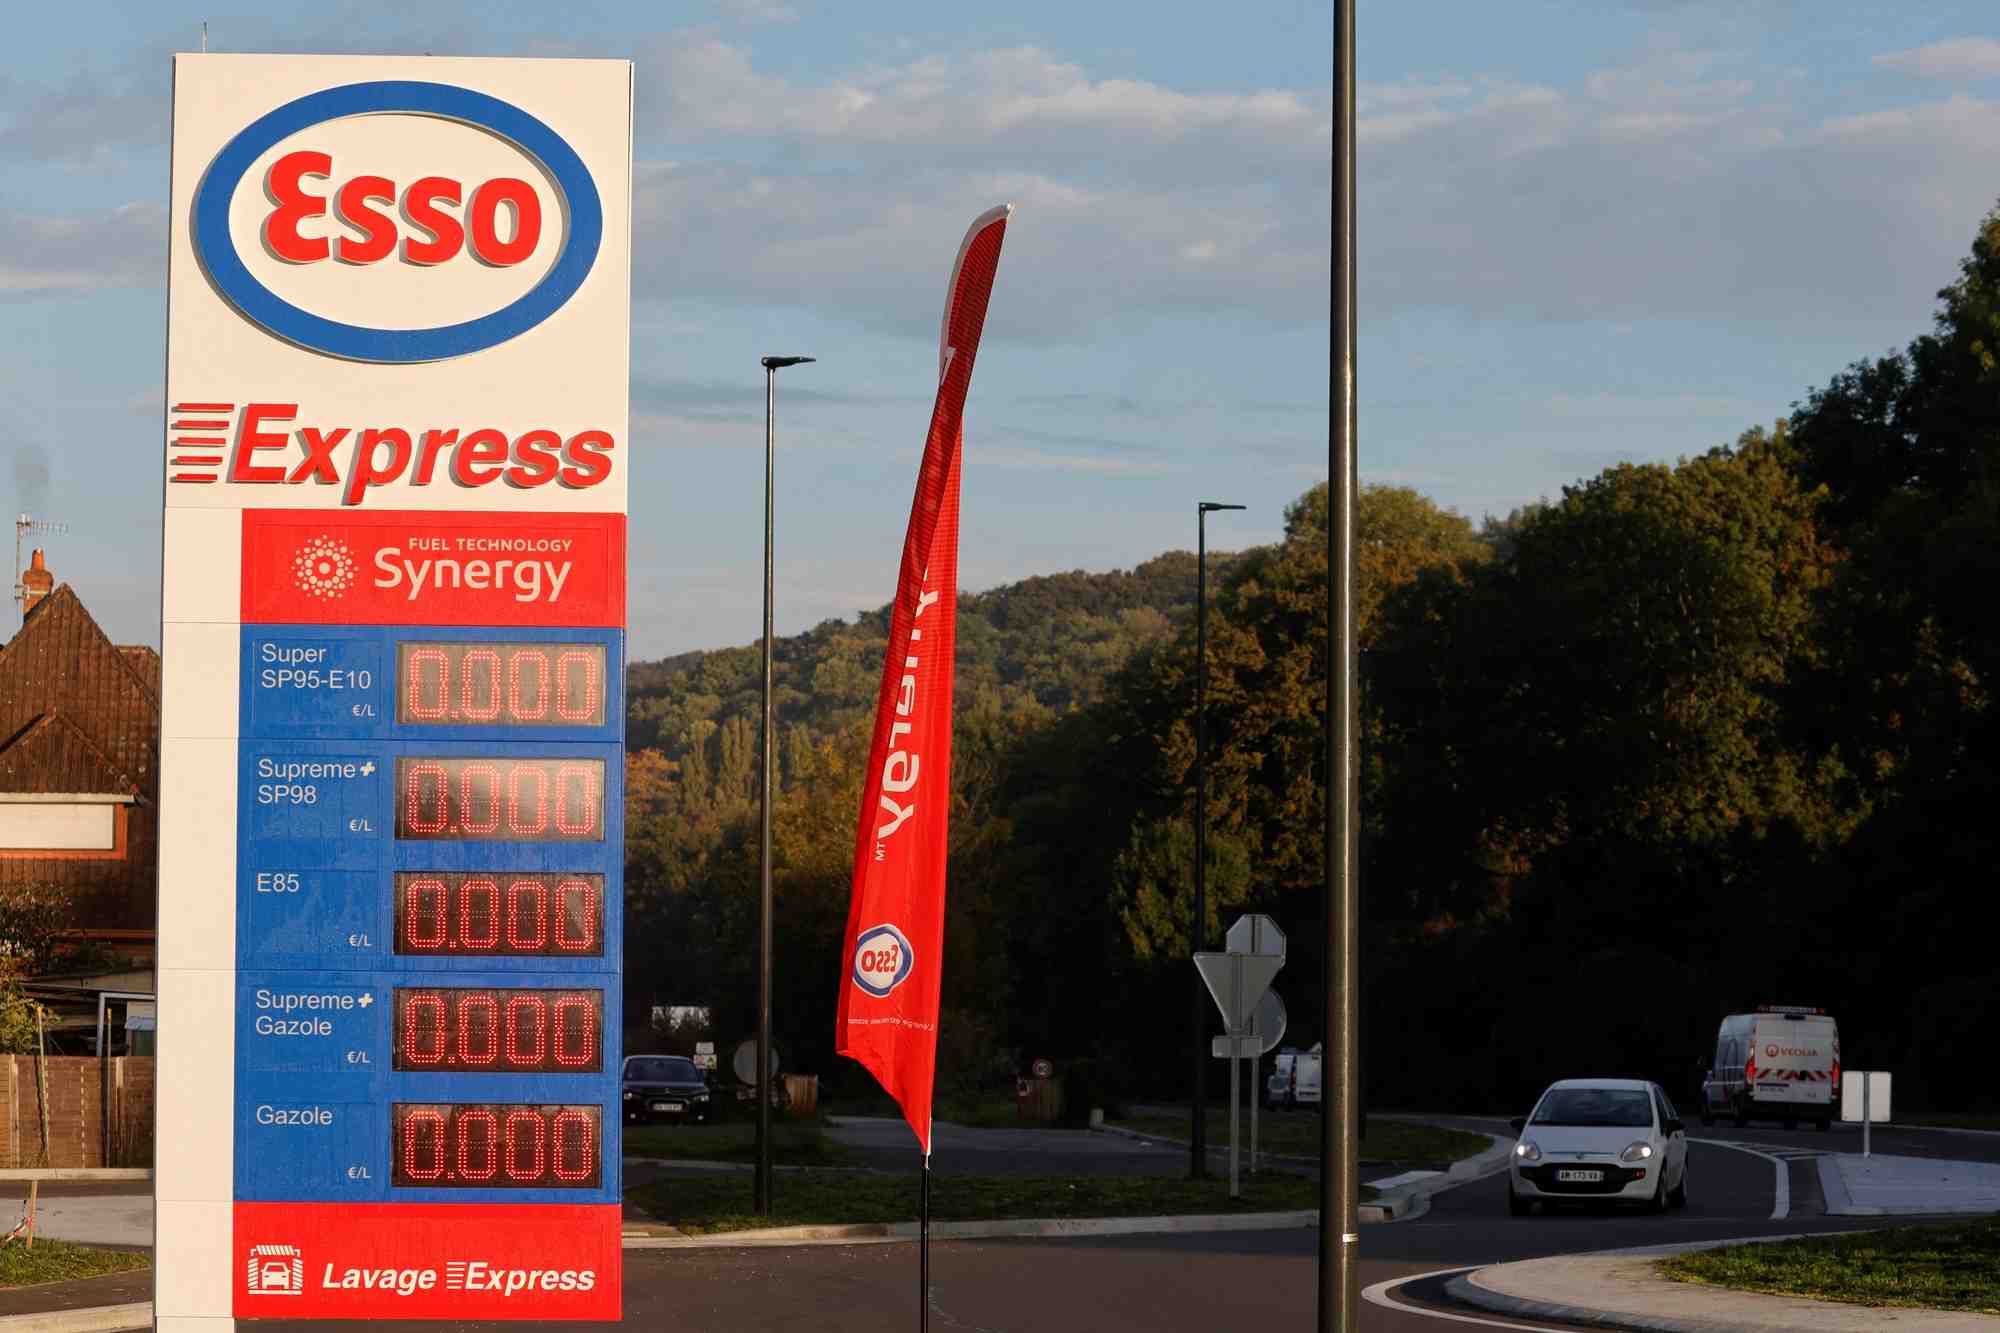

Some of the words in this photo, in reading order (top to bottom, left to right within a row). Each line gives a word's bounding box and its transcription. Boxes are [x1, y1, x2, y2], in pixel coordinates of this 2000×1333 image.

[263, 150, 542, 266] Esso
[230, 403, 615, 505] Express
[408, 537, 450, 551] FUEL
[456, 538, 573, 552] TECHNOLOGY
[373, 547, 573, 602] Synergy
[261, 643, 326, 667] Super
[261, 670, 372, 690] SP95-E10
[409, 649, 597, 720] 0.000
[352, 703, 375, 717] €/L
[257, 784, 317, 804] SP98
[408, 764, 596, 835] 0.000
[349, 820, 373, 832] €/L
[256, 873, 300, 893] E85
[407, 880, 595, 949] 0.000
[348, 935, 372, 947] €/L
[255, 1016, 332, 1036] Gazole
[405, 995, 593, 1065] 0.000
[347, 1051, 370, 1064] €/L
[255, 1105, 333, 1126] Gazole
[405, 1110, 593, 1180] 0.000
[347, 1167, 371, 1179] €/L
[322, 1263, 437, 1295] Lavage
[465, 1262, 596, 1296] Express
